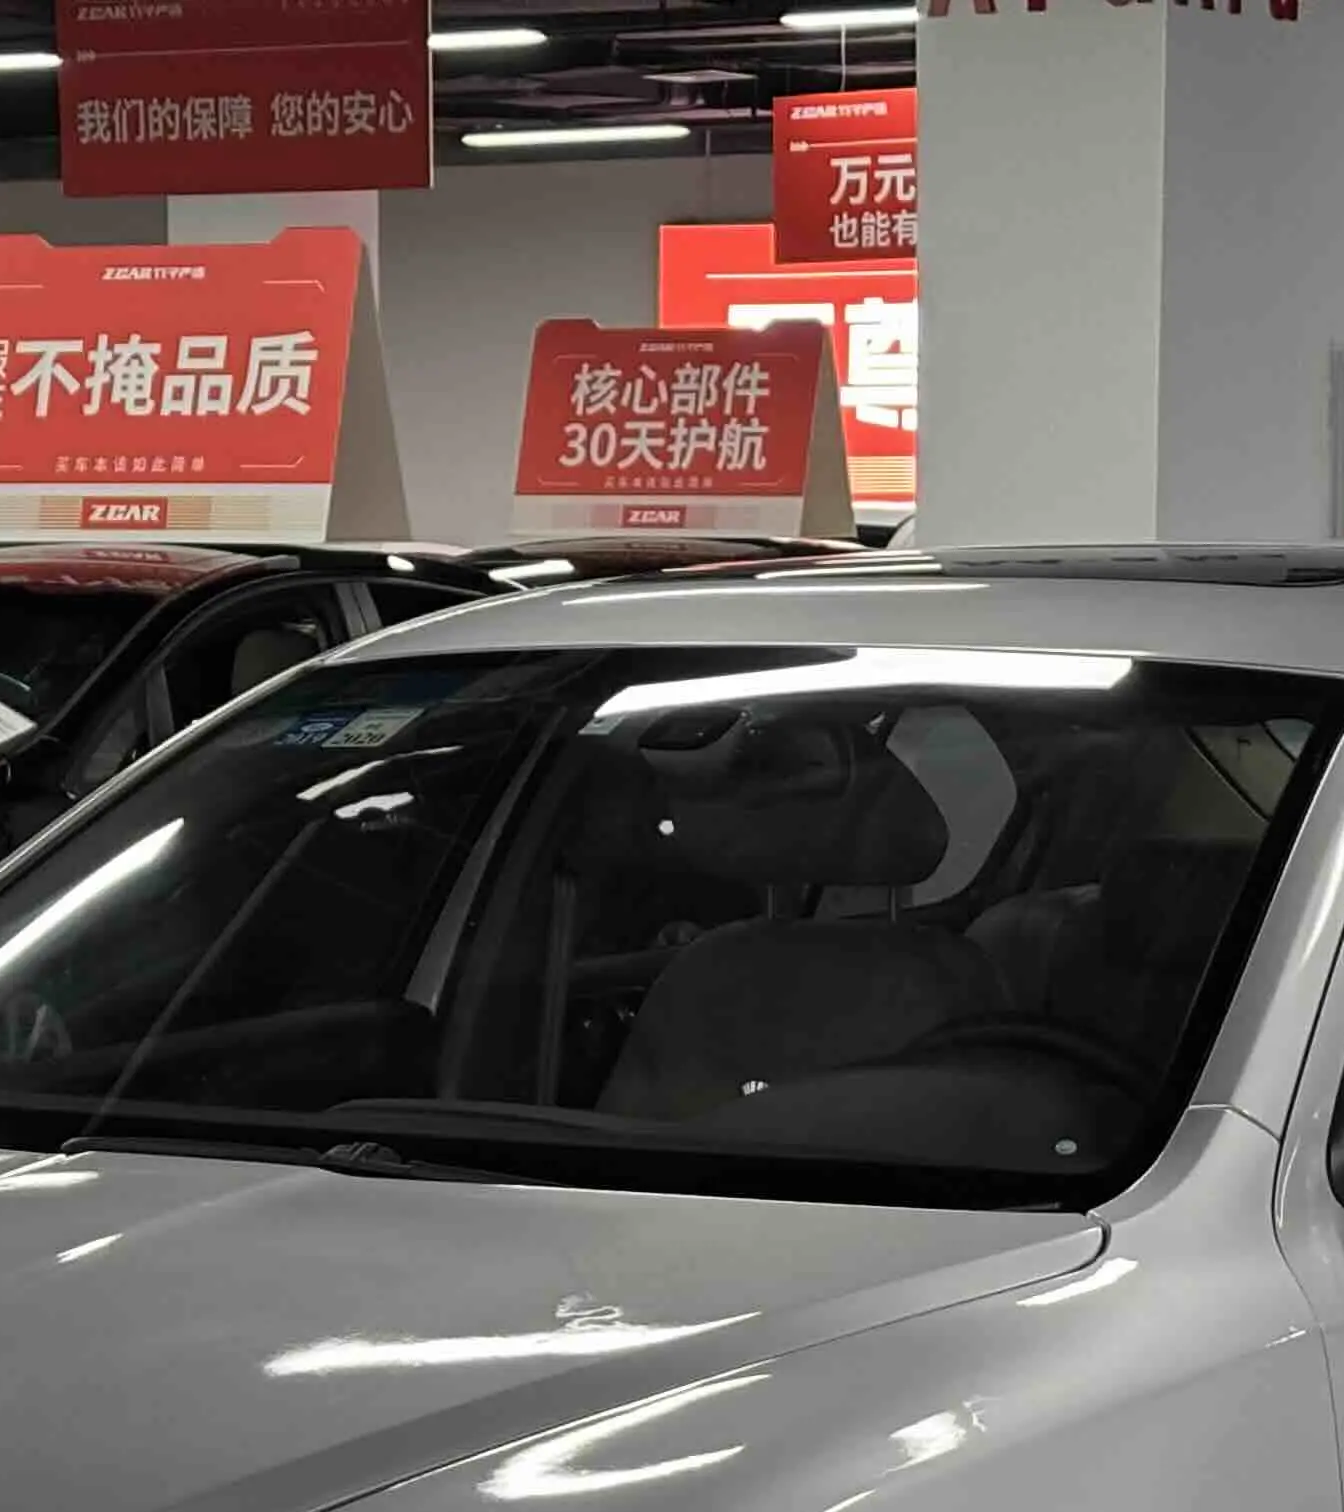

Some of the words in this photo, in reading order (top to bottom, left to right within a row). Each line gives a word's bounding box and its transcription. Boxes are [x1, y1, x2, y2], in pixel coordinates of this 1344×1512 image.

[77, 93, 253, 145] 我们的保障
[270, 89, 414, 137] 您的安心
[829, 153, 916, 206] 万元
[829, 208, 918, 248] 也能有
[10, 331, 319, 418] 不掩品质
[570, 362, 771, 417] 核心部件
[728, 297, 919, 432] 尊
[559, 418, 769, 471] 30天护航
[87, 504, 161, 521] ZCAR
